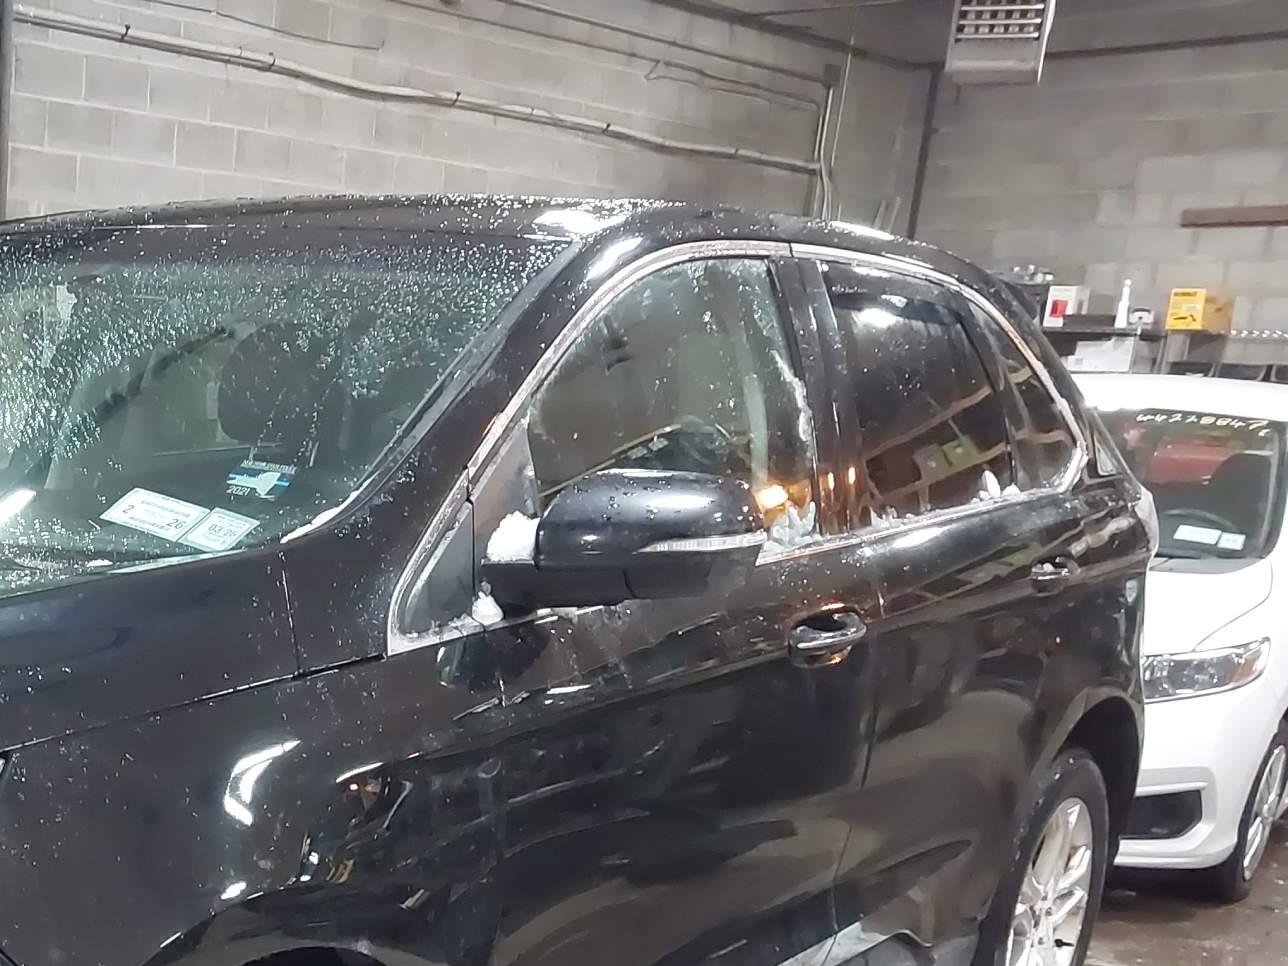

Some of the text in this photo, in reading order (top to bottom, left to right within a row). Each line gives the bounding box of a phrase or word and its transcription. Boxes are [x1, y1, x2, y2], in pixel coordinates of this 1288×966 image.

[225, 485, 251, 497] 2021
[122, 504, 135, 514] 2
[165, 518, 186, 530] 26
